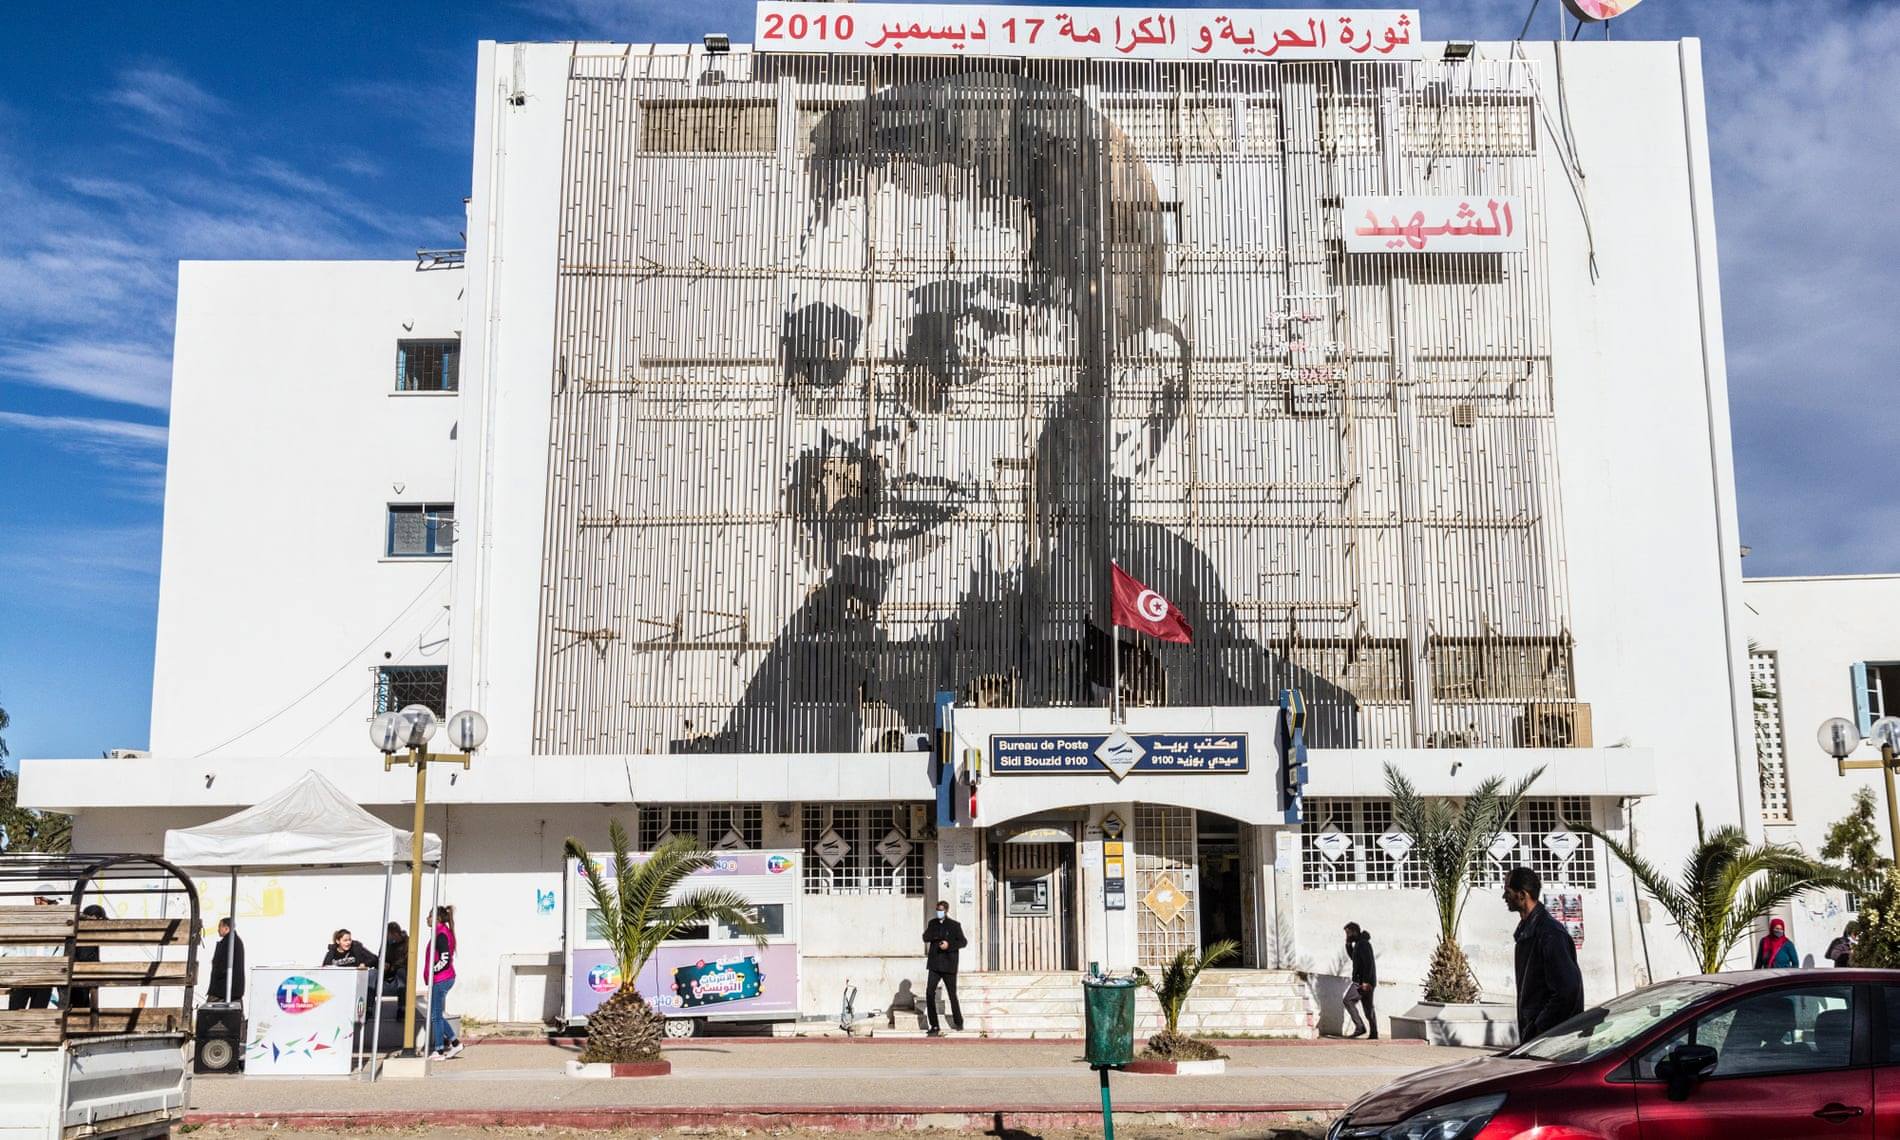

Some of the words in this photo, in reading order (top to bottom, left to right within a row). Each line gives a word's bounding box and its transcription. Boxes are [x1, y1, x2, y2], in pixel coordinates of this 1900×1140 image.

[763, 13, 855, 41] 2010
[865, 17, 987, 49] ديسمبر
[1003, 17, 1045, 44] 17
[1339, 14, 1410, 54] ثورة
[1355, 200, 1514, 250] الشهيد
[998, 740, 1039, 751] Bureau
[1040, 739, 1055, 751] de
[1056, 739, 1089, 750] Poste
[1153, 741, 1189, 753] بريد
[1193, 737, 1238, 753] مكتب
[1000, 755, 1022, 767] Sidi
[1023, 755, 1062, 767] Bouzid
[1064, 756, 1089, 766] 9100
[1151, 755, 1174, 765] 9100
[1176, 754, 1205, 768] بوزيد
[1207, 756, 1239, 769] سيدي
[591, 969, 615, 984] TT
[281, 984, 314, 1003] TT
